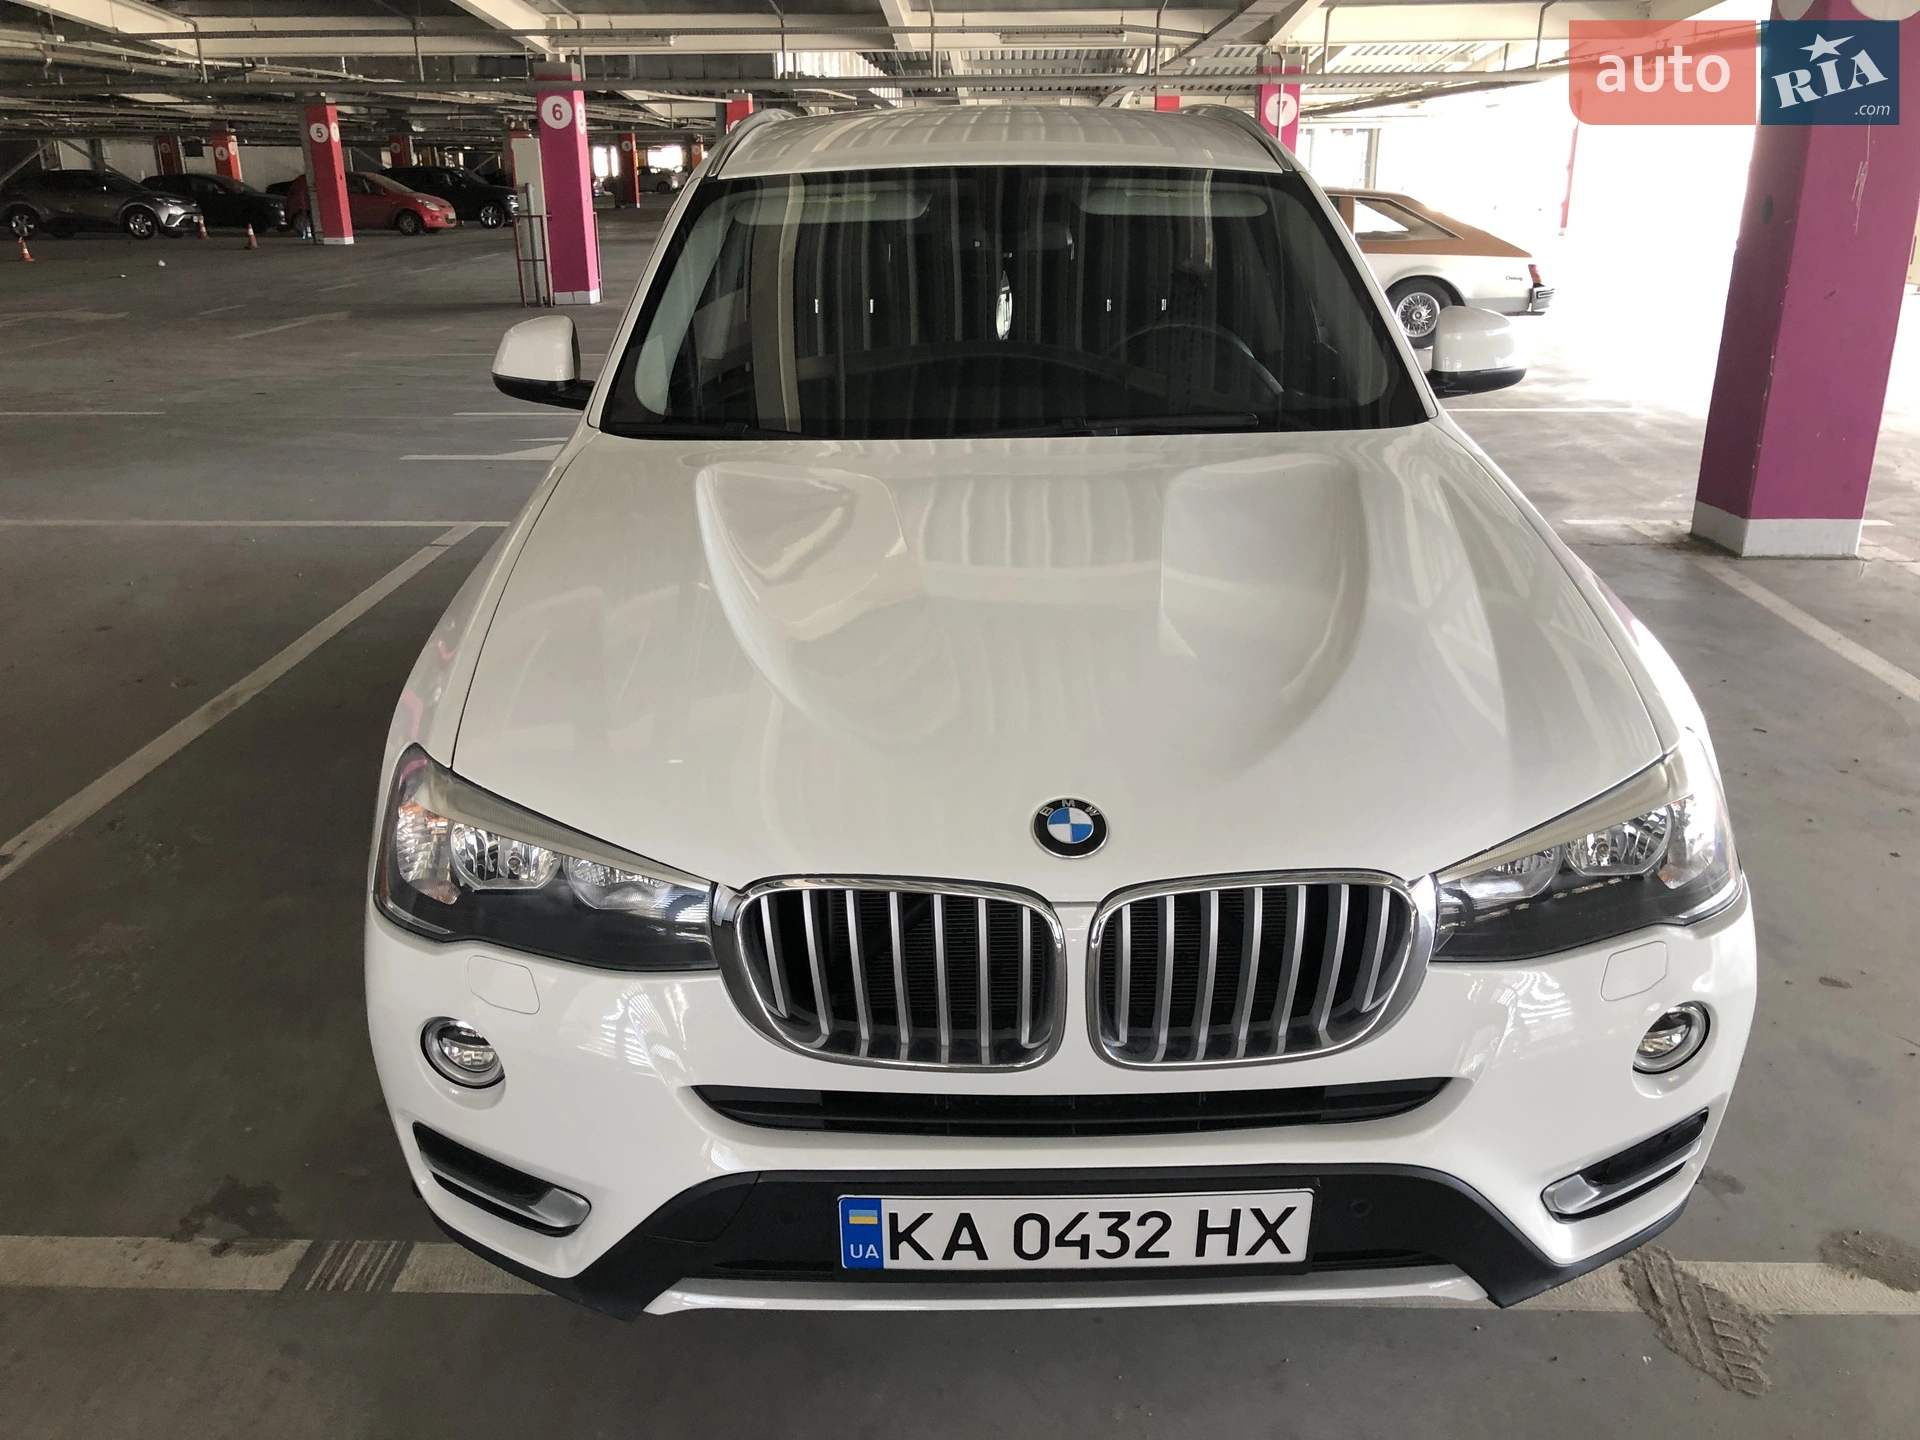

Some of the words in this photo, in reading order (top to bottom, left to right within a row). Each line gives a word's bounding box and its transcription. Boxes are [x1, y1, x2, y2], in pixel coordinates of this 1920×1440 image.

[552, 103, 563, 121] 6
[1276, 100, 1288, 116] 7
[316, 127, 324, 138] 5
[1039, 799, 1101, 817] BMW
[888, 1212, 989, 1261] KA
[1013, 1210, 1173, 1261] 0432
[1195, 1206, 1298, 1258] HX
[850, 1243, 880, 1259] UA
